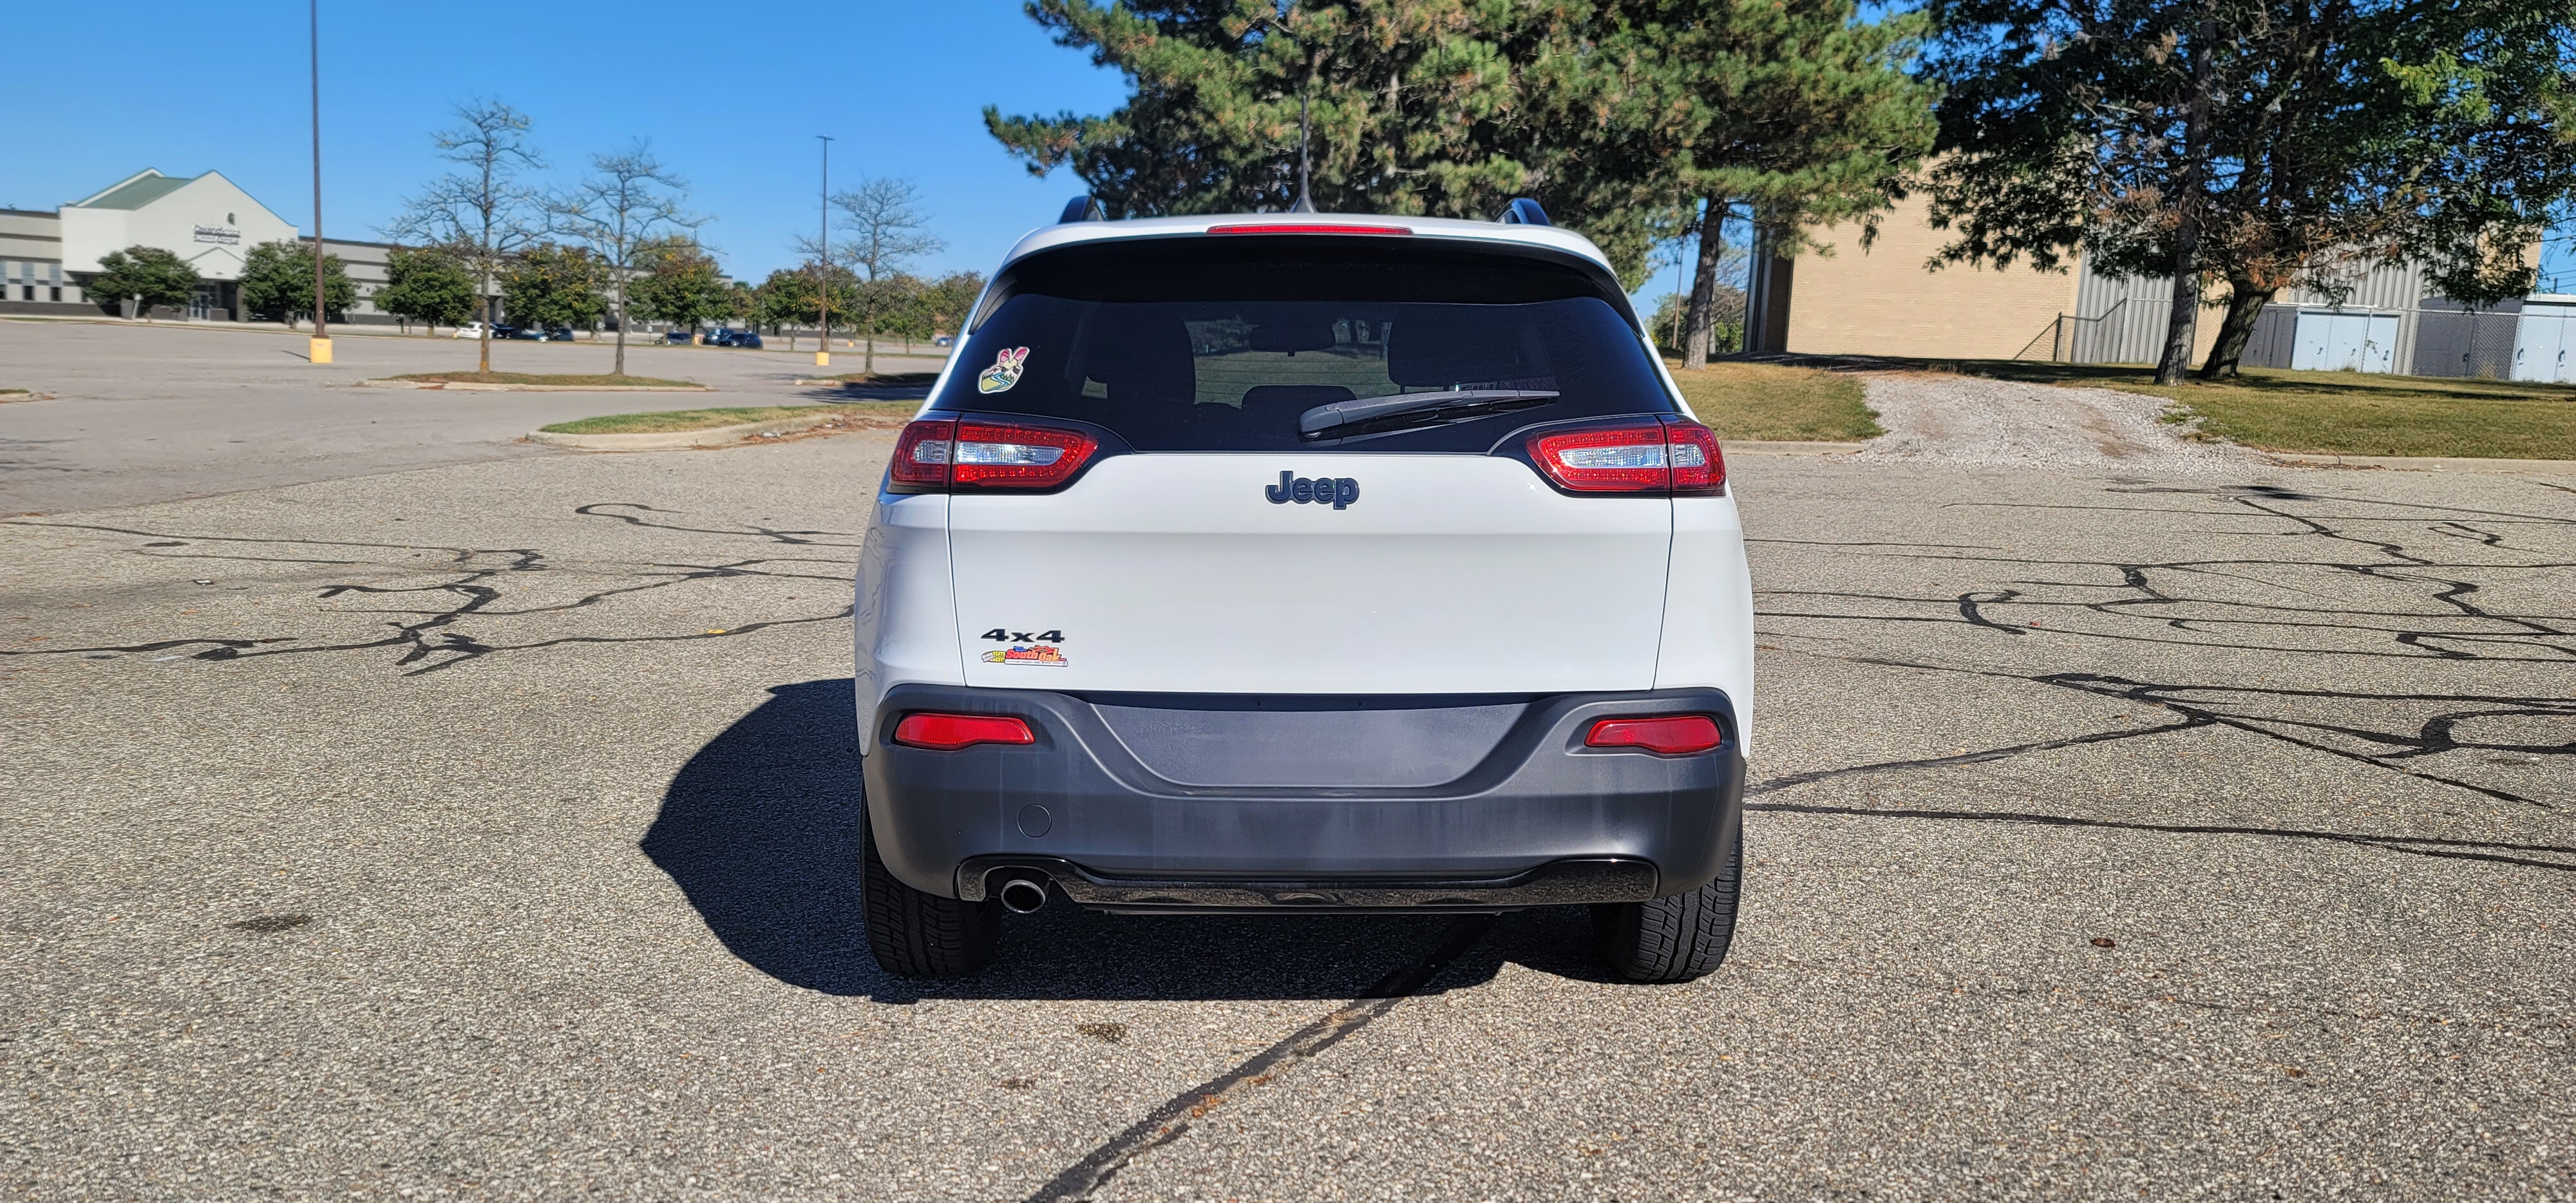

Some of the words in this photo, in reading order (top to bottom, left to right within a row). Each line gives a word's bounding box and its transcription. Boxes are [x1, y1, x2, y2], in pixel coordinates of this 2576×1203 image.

[1265, 471, 1359, 510] Jeep
[981, 629, 1065, 643] 4x4
[1006, 649, 1038, 659] South
[1038, 649, 1061, 661] Oak
